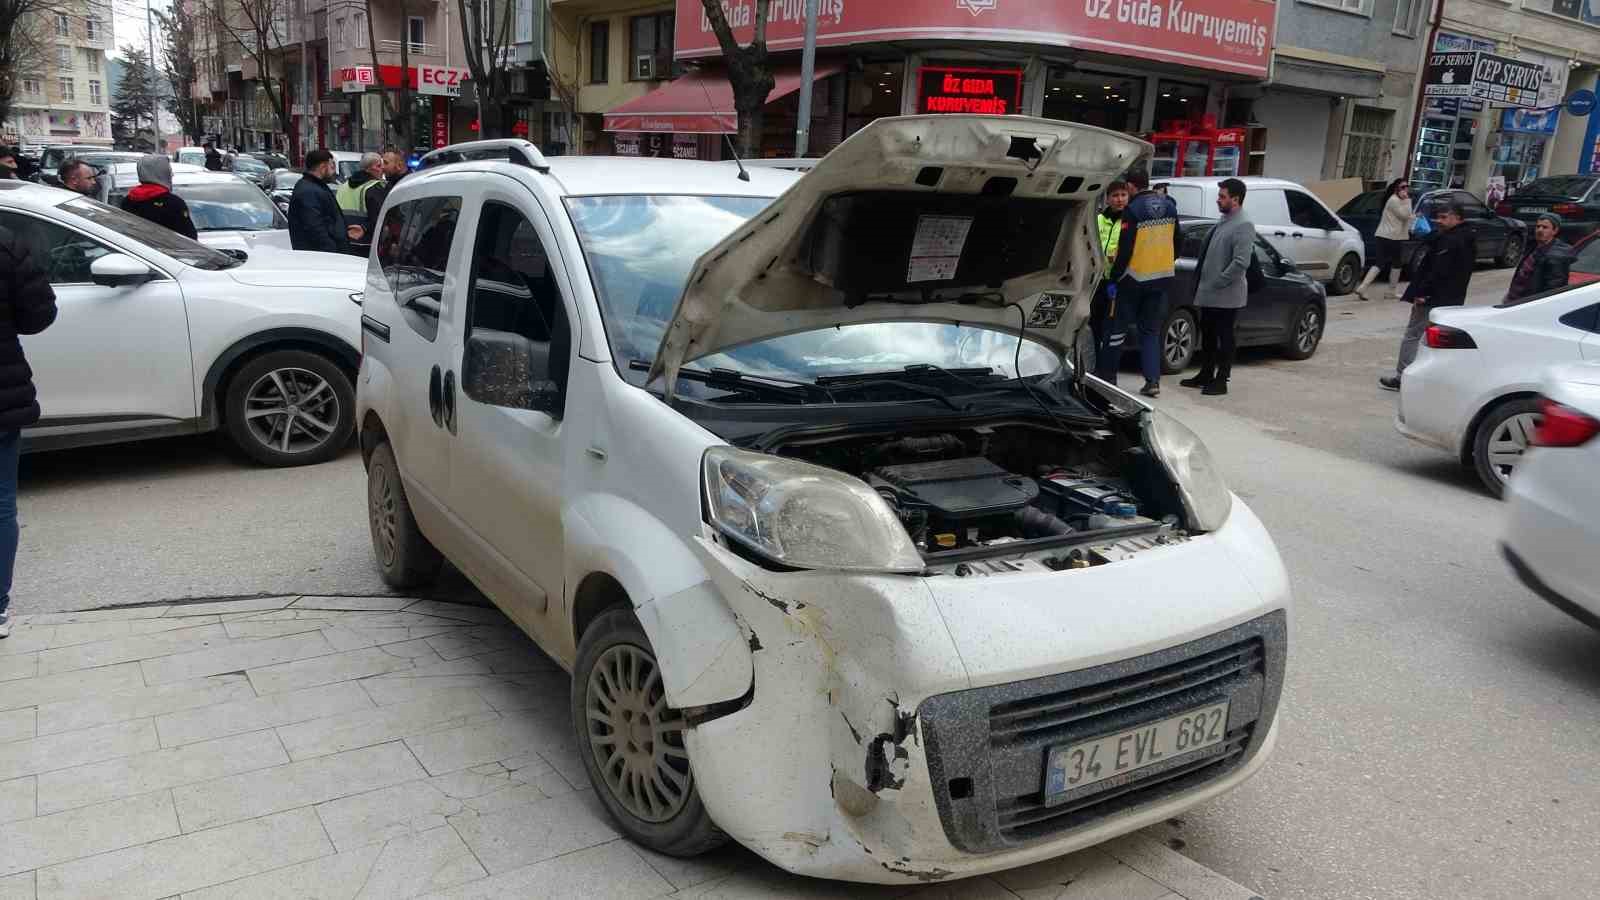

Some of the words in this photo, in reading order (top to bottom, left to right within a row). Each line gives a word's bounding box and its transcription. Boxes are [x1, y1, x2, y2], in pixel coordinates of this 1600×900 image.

[1117, 0, 1161, 28] Gıda
[1167, 0, 1268, 56] Kuruyemiş
[1430, 55, 1446, 66] CEP
[1477, 58, 1502, 82] CEP
[1501, 63, 1543, 90] SERVİS
[943, 73, 961, 93] ÖZ
[962, 79, 994, 94] GIDA
[1067, 744, 1103, 785] 34
[1114, 727, 1162, 771] EVL
[1175, 707, 1223, 751] 682
